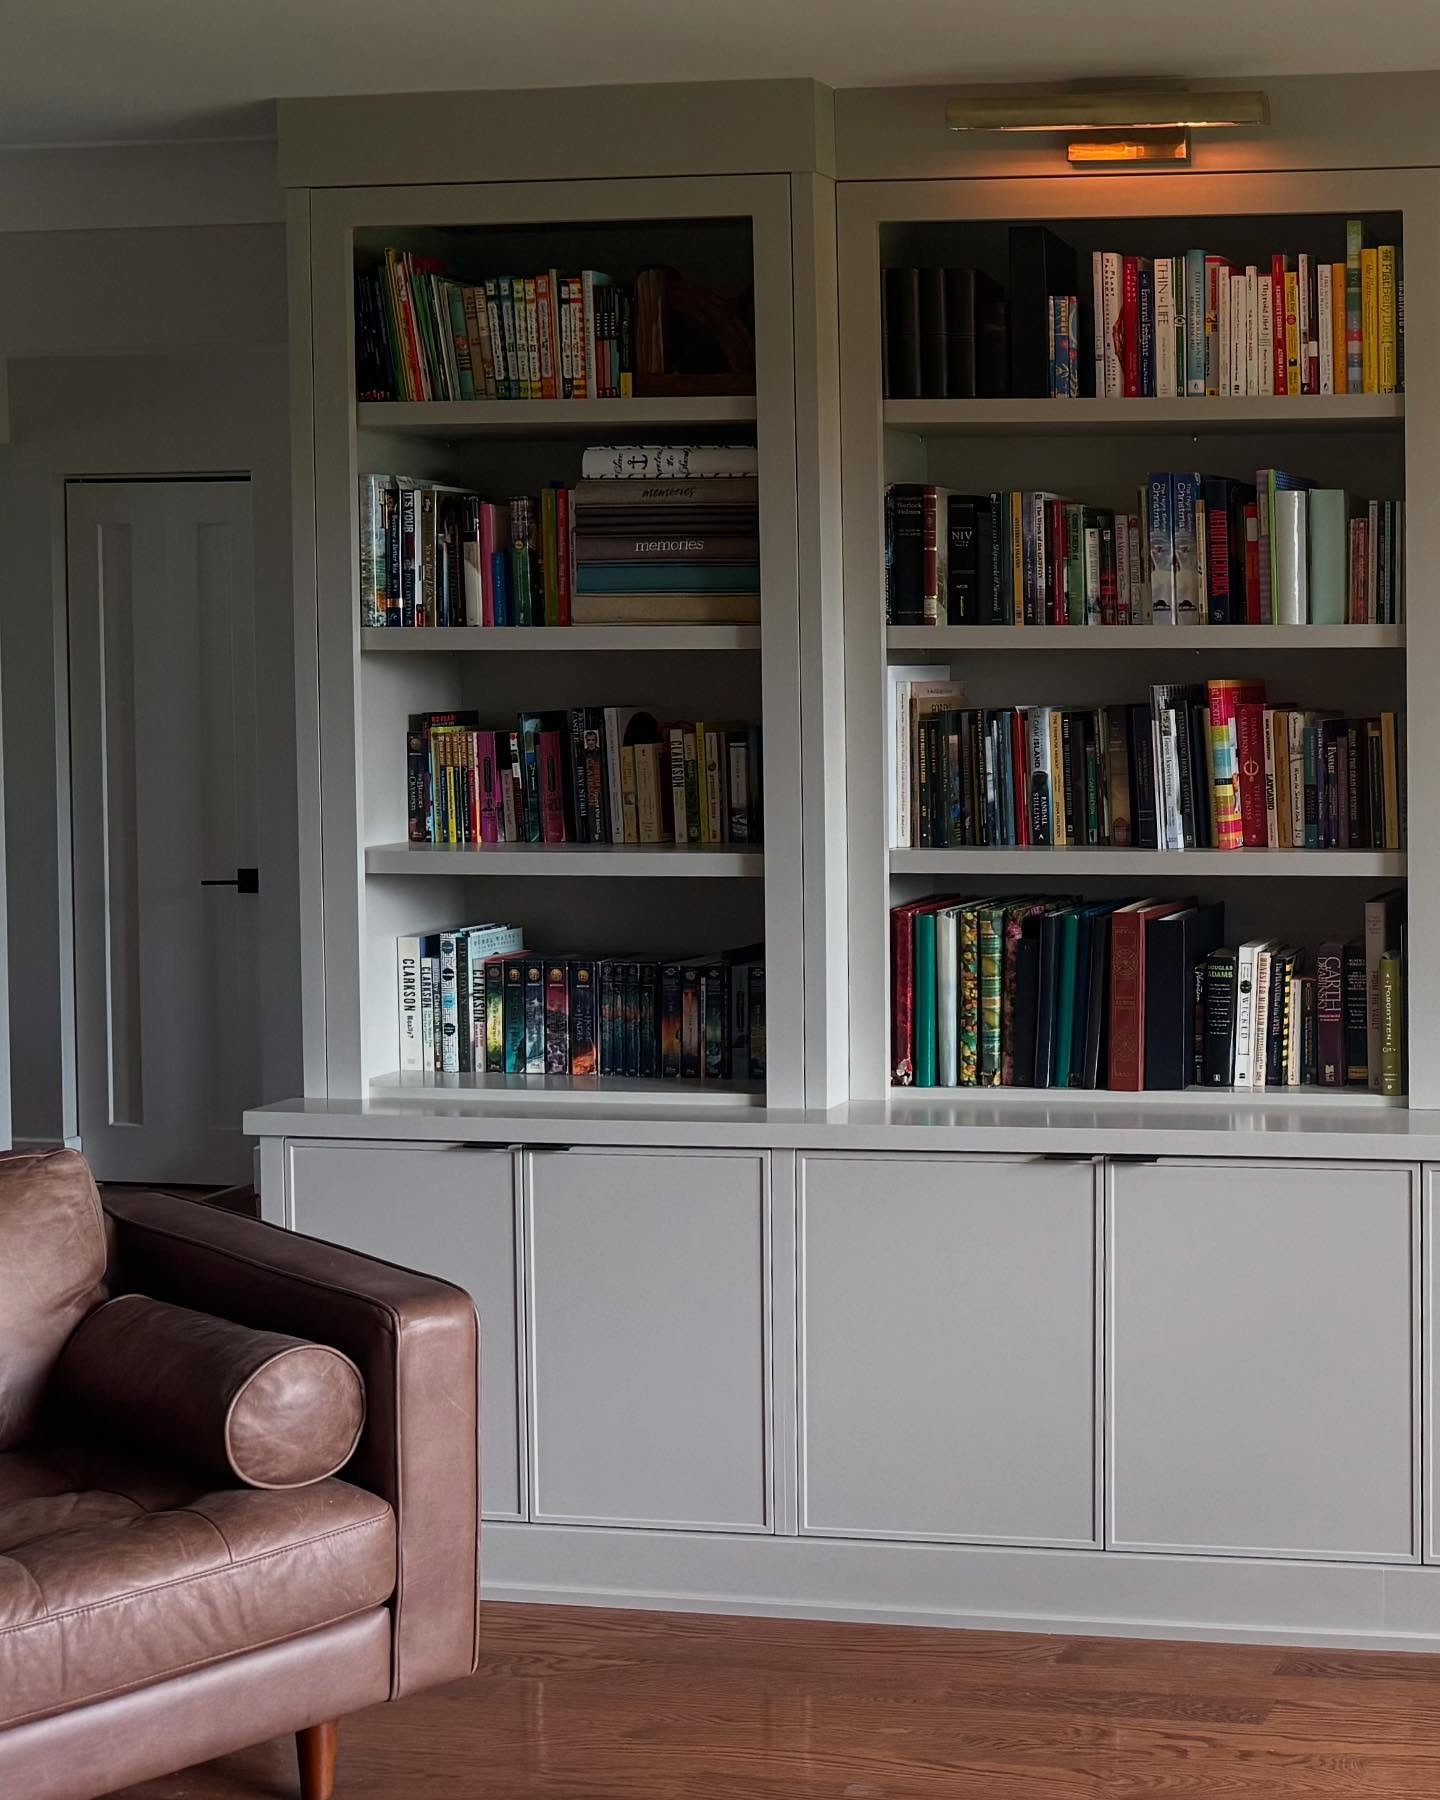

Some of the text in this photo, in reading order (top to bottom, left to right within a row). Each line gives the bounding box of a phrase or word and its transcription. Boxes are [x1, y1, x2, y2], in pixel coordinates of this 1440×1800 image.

[1157, 263, 1169, 294] THIN
[1382, 264, 1393, 286] Flat
[1158, 304, 1169, 327] LIFE
[641, 486, 697, 499] memories
[1160, 483, 1168, 496] The
[1185, 483, 1193, 495] The
[403, 492, 415, 534] IT'S YOUR
[1036, 506, 1044, 517] The
[634, 538, 705, 553] memories
[951, 530, 974, 541] NIV
[1212, 698, 1223, 726] home
[1033, 719, 1042, 769] OAK ISLAND
[671, 740, 685, 788] CLARKSON
[1328, 746, 1337, 775] FANFARE
[578, 789, 588, 817] STORM
[1032, 792, 1040, 831] SULLIVAN
[1041, 796, 1049, 826] RANDALL
[459, 942, 467, 956] UP
[421, 966, 432, 1008] CLARKSON
[460, 971, 468, 1006] DOWN
[1208, 971, 1234, 979] ADAMS
[1317, 956, 1328, 1011] DRABINSKY
[1325, 956, 1342, 1011] GARTH
[402, 958, 416, 1039] CLARKSON Really?
[434, 993, 442, 1026] Clarkson
[472, 968, 486, 1023] CLARKSON
[1241, 996, 1250, 1039] WICKED
[1384, 984, 1392, 1040] FORGOTTEN
